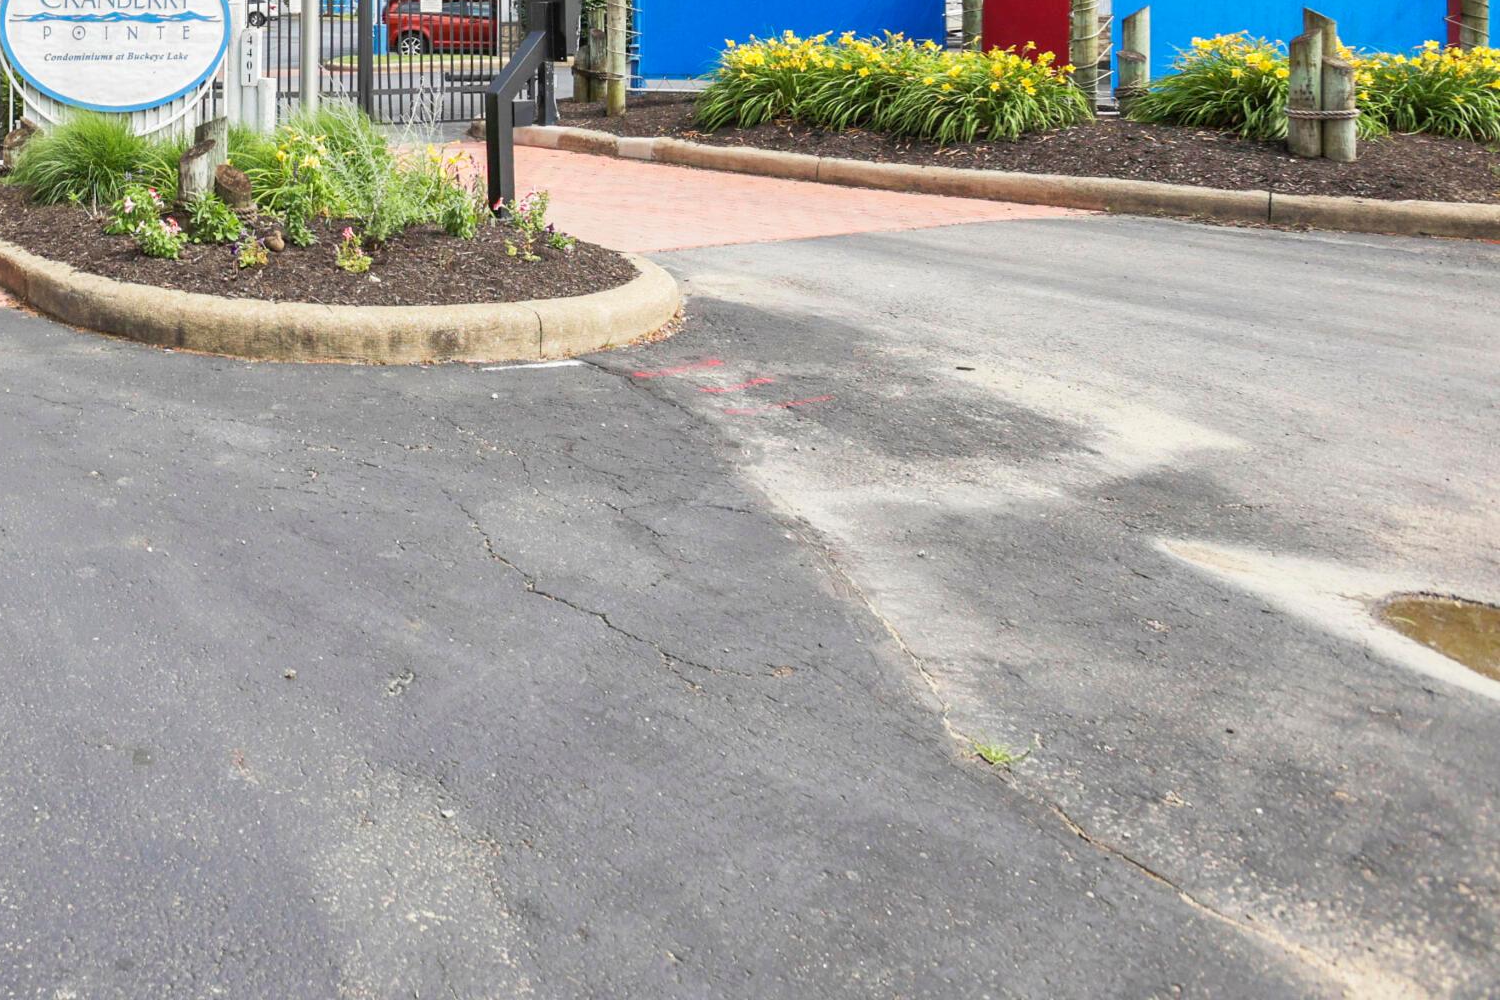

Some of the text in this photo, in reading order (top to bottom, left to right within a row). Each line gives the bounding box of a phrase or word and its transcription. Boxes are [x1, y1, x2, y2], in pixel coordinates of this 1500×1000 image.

[43, 25, 190, 41] POINTE
[44, 52, 189, 63] Condominiums at Buckeye Lake
